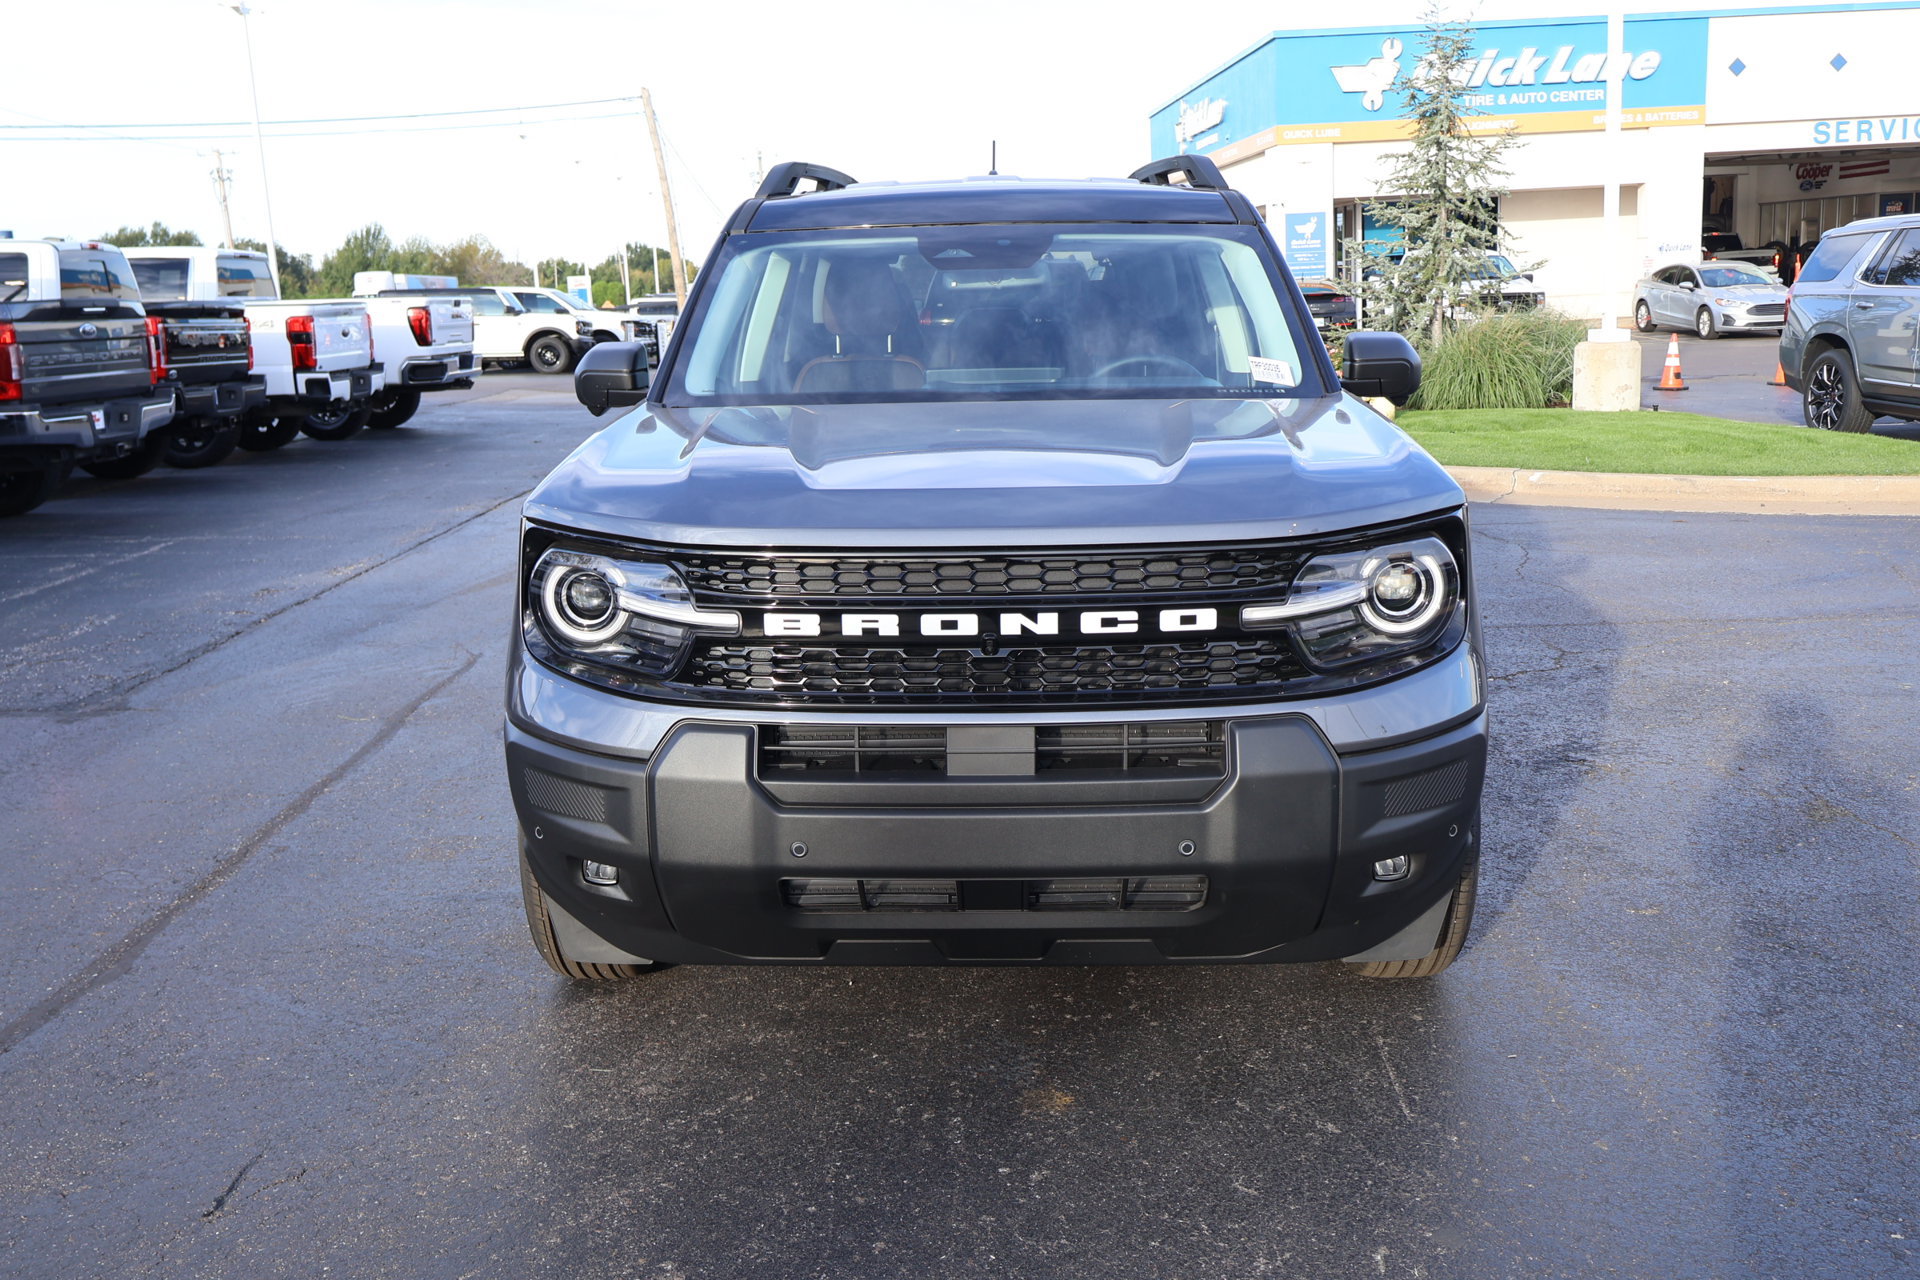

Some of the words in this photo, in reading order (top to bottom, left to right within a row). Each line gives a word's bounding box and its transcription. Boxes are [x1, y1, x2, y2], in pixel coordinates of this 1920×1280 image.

[1463, 95, 1494, 107] TIRE
[1497, 94, 1507, 105] &
[1510, 91, 1547, 104] AUTO
[1550, 89, 1605, 102] CENTER
[1645, 111, 1699, 122] BATTERIES
[1283, 129, 1313, 139] QUICK
[1315, 128, 1341, 137] LUBE
[763, 607, 1218, 637] BRONCO
